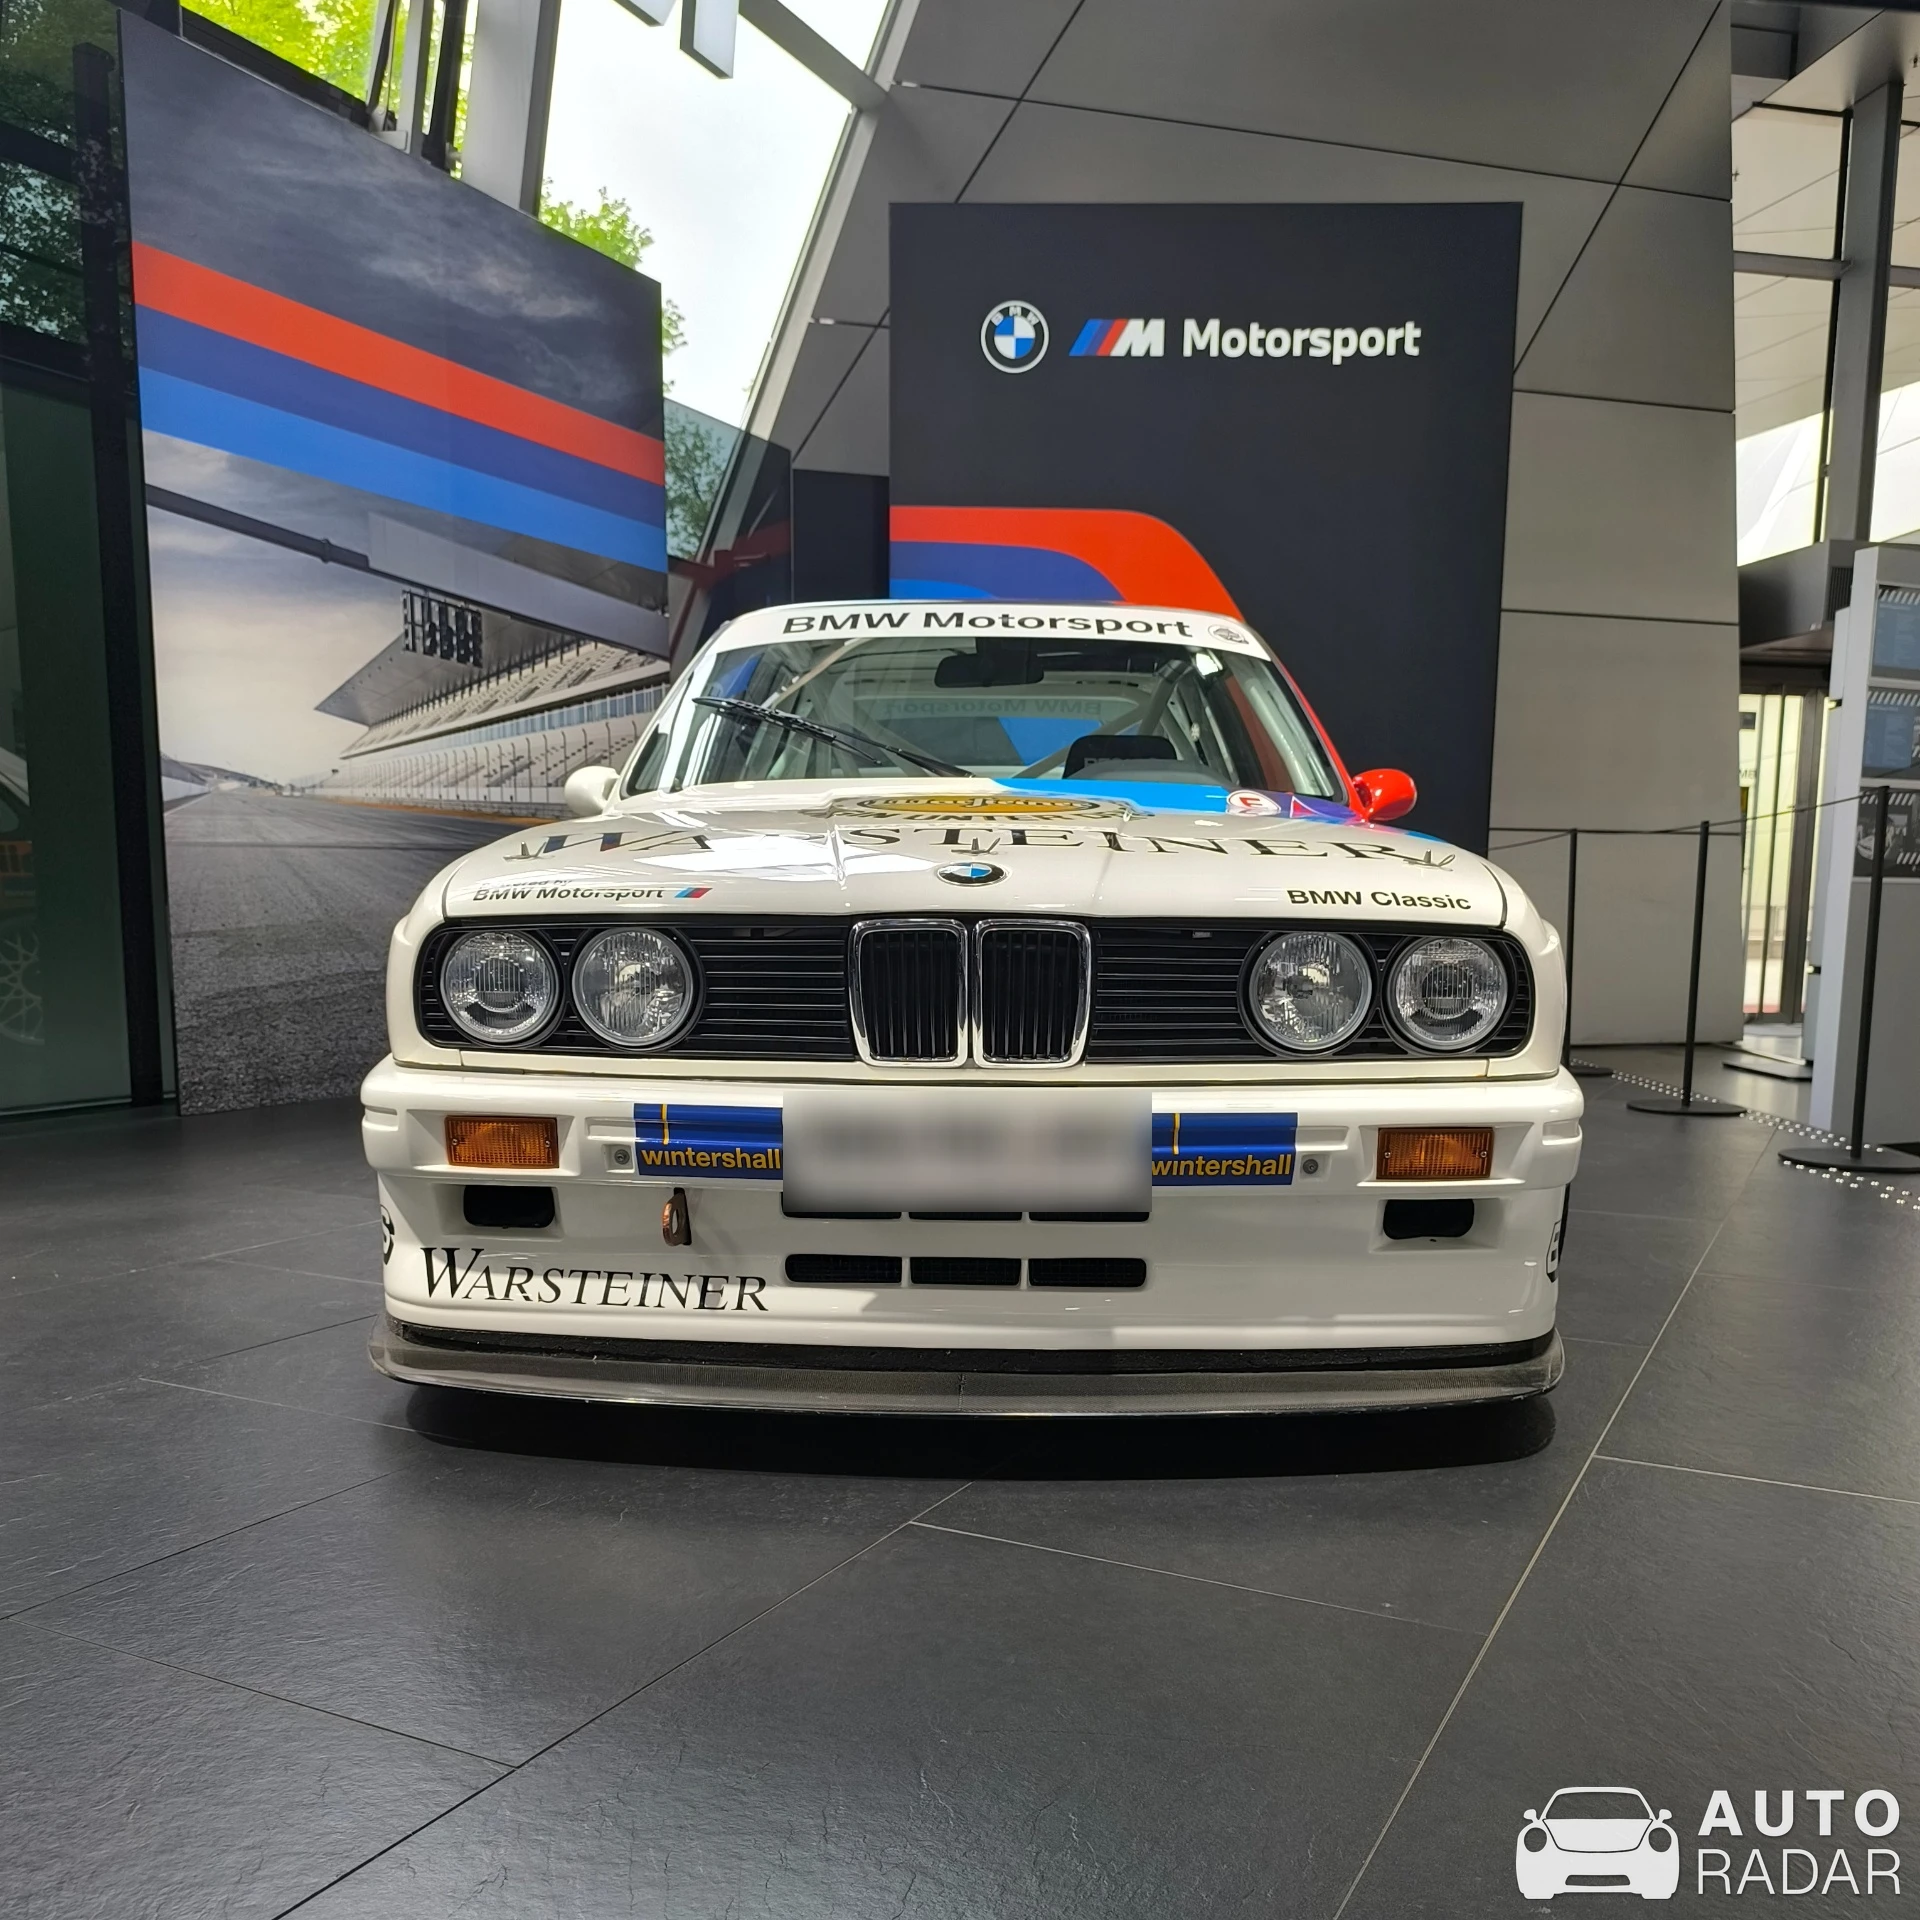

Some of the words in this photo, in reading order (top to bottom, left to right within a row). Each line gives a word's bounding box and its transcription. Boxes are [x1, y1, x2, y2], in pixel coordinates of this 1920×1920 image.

[990, 306, 1040, 326] BMW
[1182, 318, 1422, 365] Motorsport
[783, 612, 910, 634] BMW
[923, 612, 1193, 638] Motorsport
[542, 828, 1428, 862] WASTEINER
[473, 887, 532, 901] BMW
[536, 887, 665, 901] Motorsport
[1287, 889, 1362, 905] BMW
[1370, 891, 1472, 910] Classic
[640, 1147, 782, 1169] wintershall
[1152, 1153, 1293, 1176] wintershall
[420, 1246, 769, 1312] WARSTEINER
